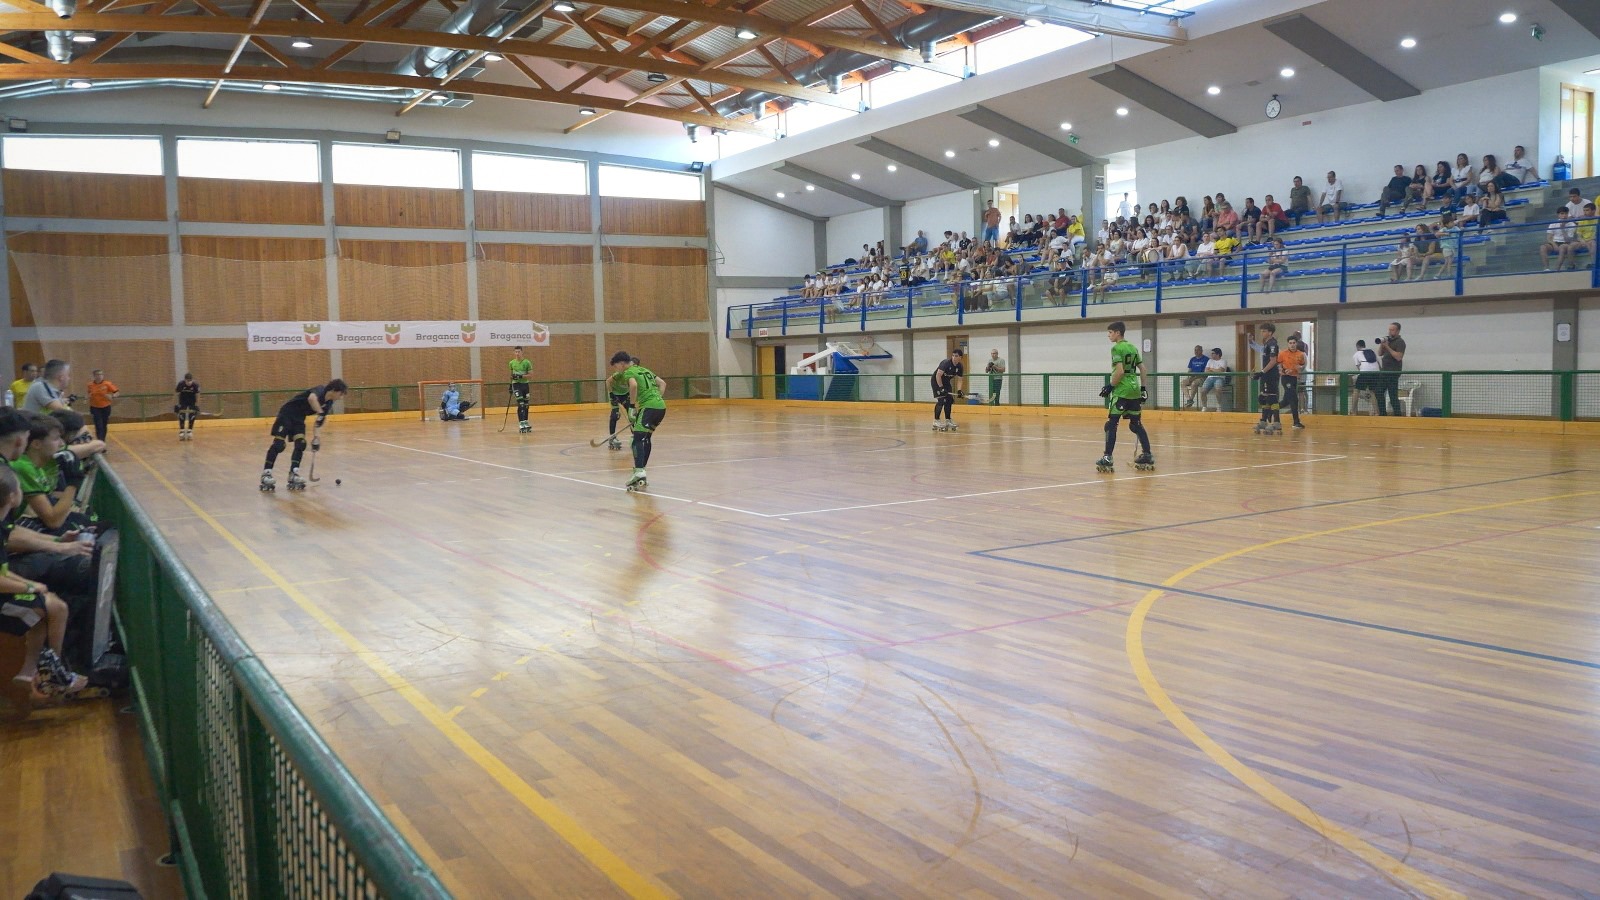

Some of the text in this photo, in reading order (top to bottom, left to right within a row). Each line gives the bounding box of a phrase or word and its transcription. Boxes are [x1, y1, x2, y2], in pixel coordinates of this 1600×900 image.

[253, 335, 303, 344] Bragança
[337, 334, 383, 343] Bragança
[416, 333, 459, 342] Bragança
[490, 332, 531, 341] Bragança
